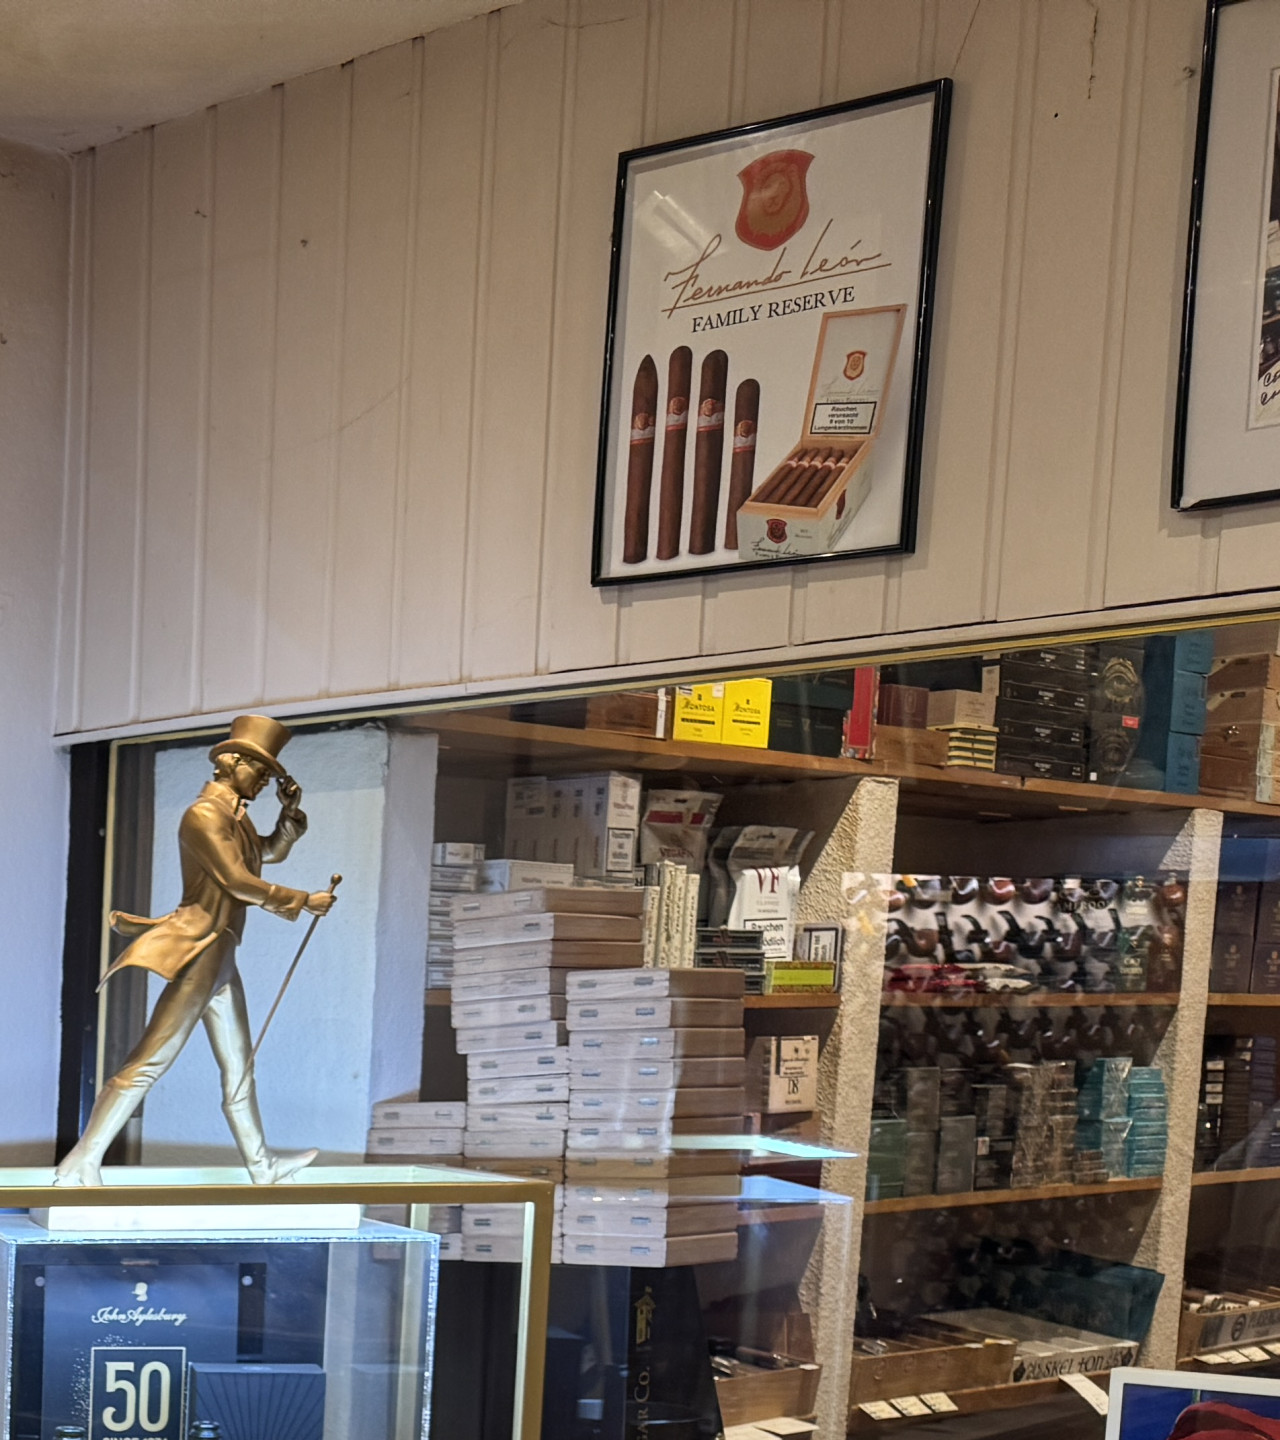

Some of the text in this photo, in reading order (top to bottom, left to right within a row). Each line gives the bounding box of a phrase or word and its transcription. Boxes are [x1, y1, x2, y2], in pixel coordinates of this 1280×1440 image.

[662, 219, 883, 318] Fernando León
[692, 286, 855, 333] FAMILY RESERVE
[761, 938, 786, 947] ödlich
[91, 1305, 188, 1327] John Aylesbury
[102, 1360, 172, 1433] 50
